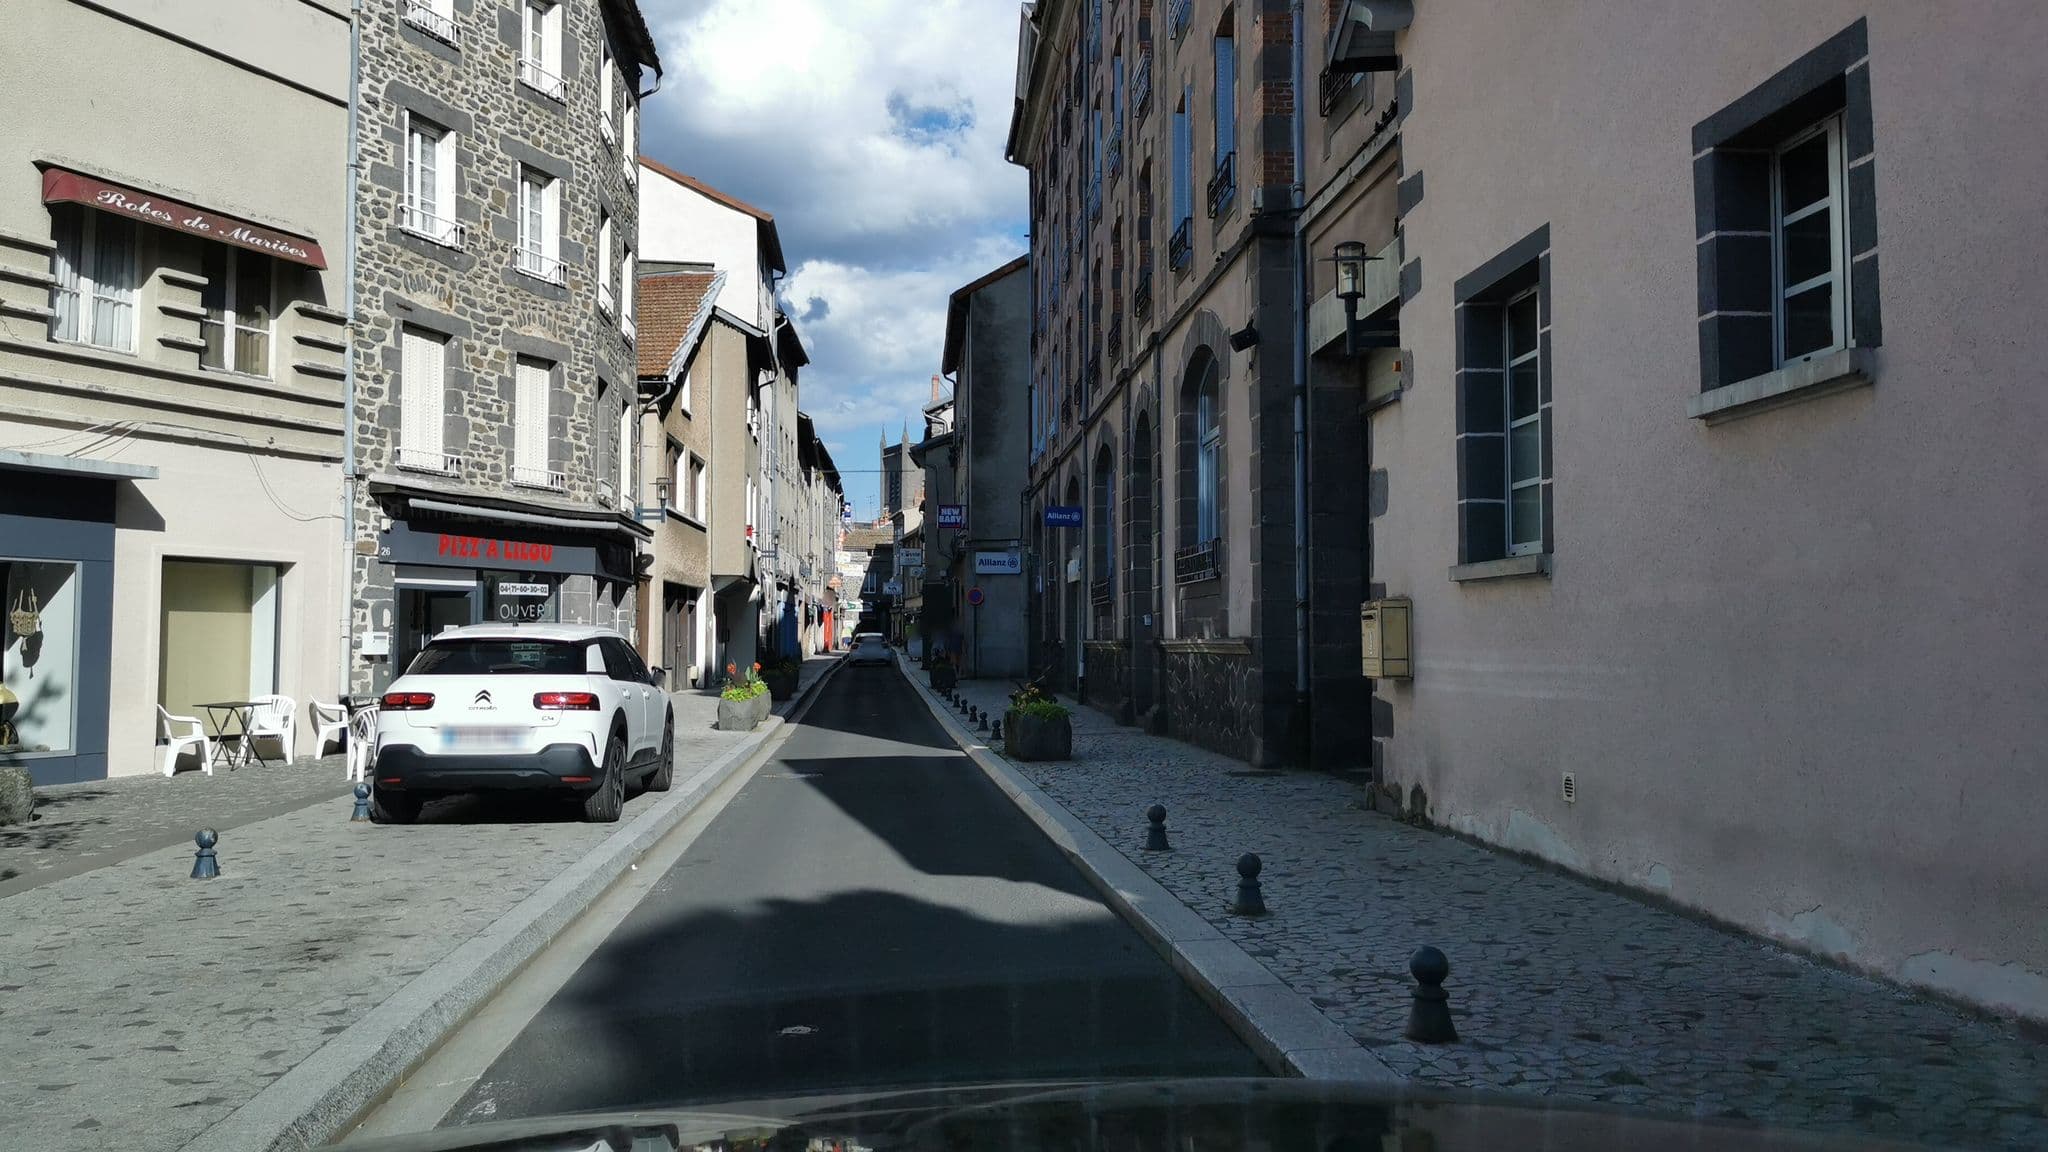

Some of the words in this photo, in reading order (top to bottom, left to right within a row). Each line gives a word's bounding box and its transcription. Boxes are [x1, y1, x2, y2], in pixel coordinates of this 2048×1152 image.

[97, 190, 172, 222] Robes
[183, 216, 210, 231] de
[219, 227, 309, 259] Mariées
[941, 508, 960, 516] NEW
[1047, 511, 1071, 520] Allianz
[939, 515, 961, 523] BABY
[438, 533, 499, 560] PIZZ'A
[503, 540, 553, 565] LILOU
[978, 558, 1007, 567] Allianz
